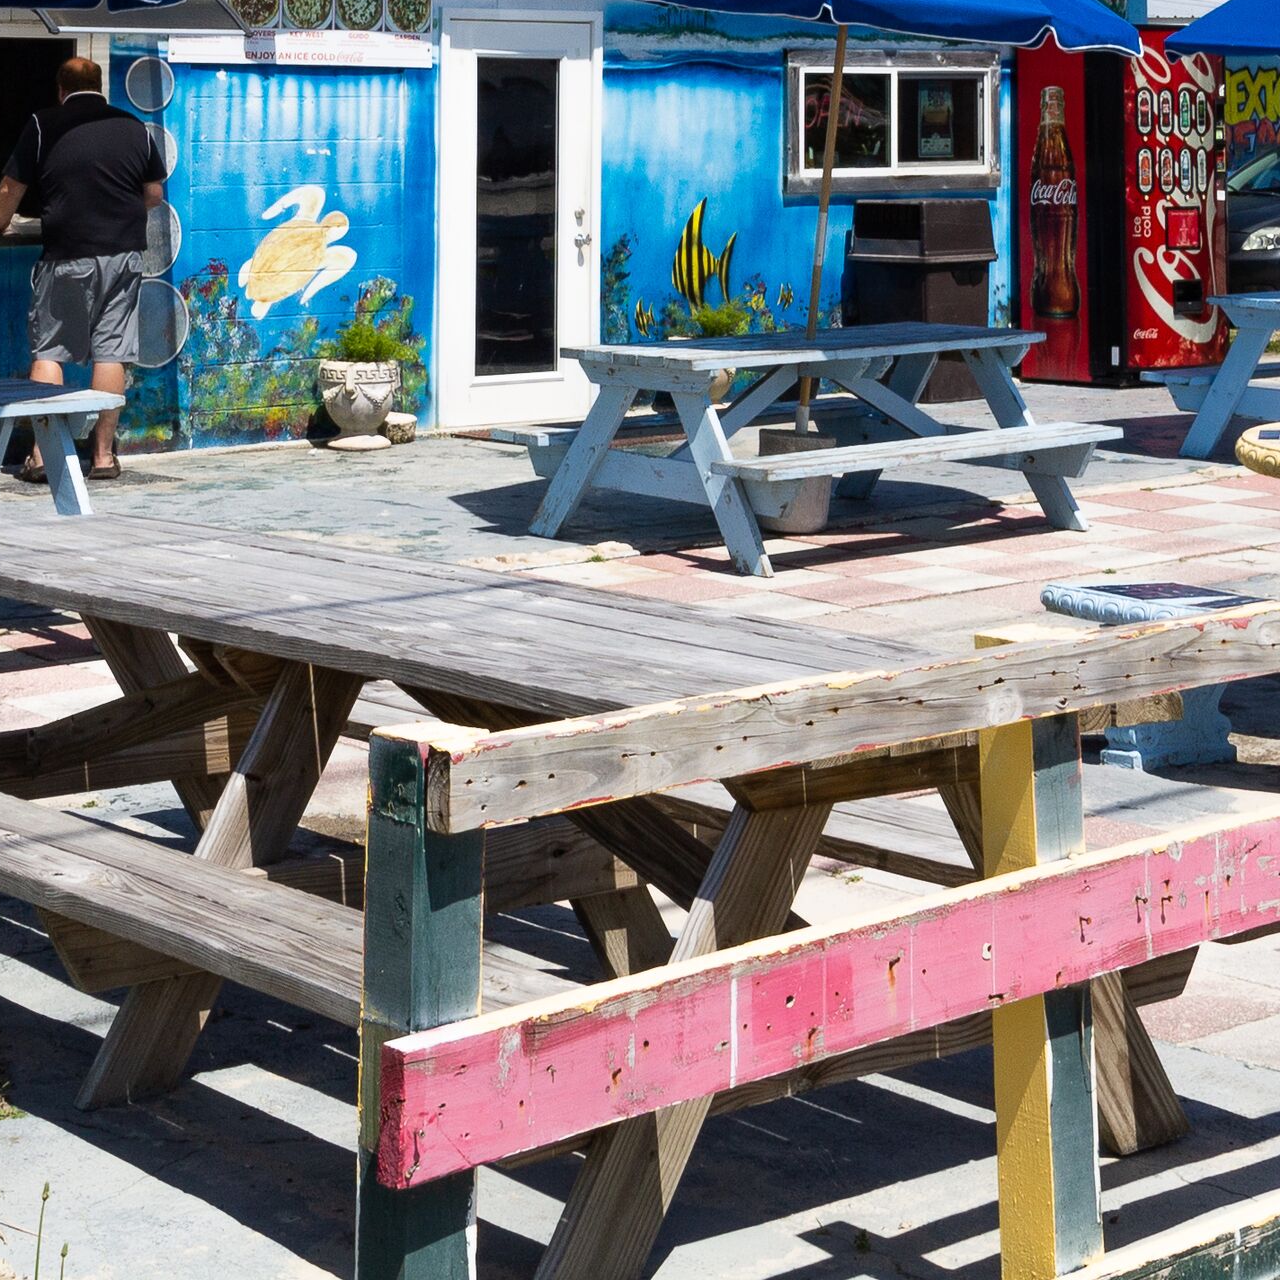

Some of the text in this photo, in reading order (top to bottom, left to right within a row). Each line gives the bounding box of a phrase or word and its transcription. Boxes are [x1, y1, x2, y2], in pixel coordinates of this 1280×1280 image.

[250, 29, 276, 37] OVERS
[245, 51, 276, 60] ENJOY
[278, 52, 292, 61] AN
[294, 52, 309, 61] ICE
[311, 52, 336, 61] COLD
[805, 93, 865, 129] OPN
[1132, 216, 1142, 238] ice
[1141, 205, 1152, 238] cold
